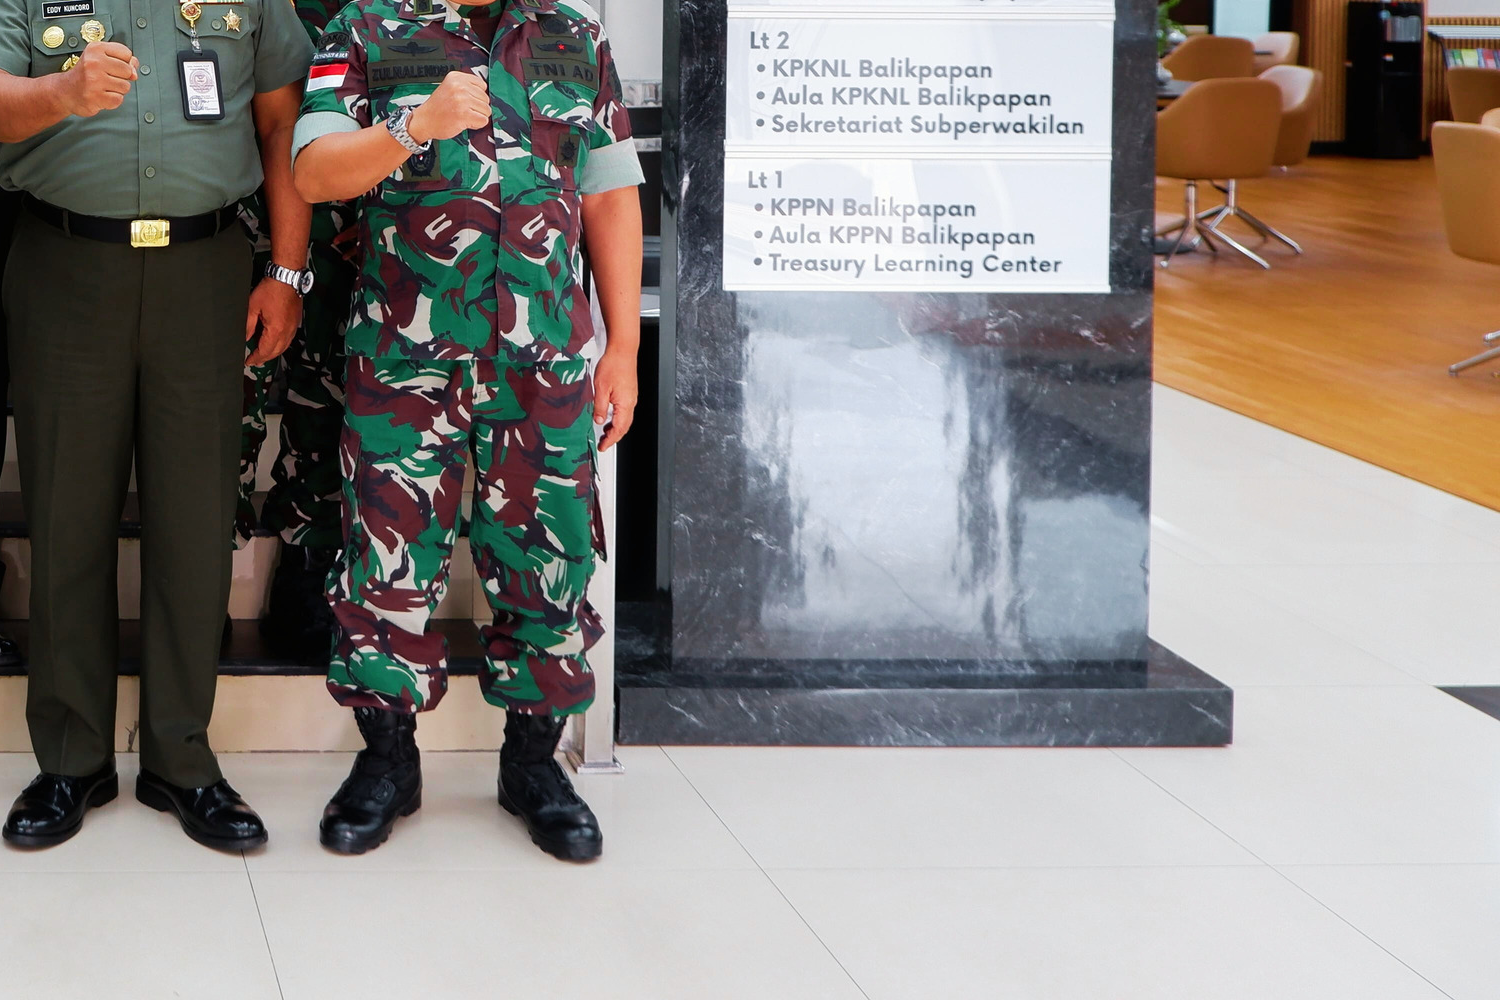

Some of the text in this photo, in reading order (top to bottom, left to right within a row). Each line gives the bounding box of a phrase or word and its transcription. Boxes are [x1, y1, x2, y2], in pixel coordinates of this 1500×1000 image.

[46, 6, 62, 14] EDDY
[750, 31, 790, 50] Lt 2
[529, 62, 594, 82] TNI AD
[772, 58, 993, 84] KPKNL Balikpapan
[771, 85, 1051, 112] Aula KPKNL Balikpapan
[771, 113, 1084, 140] Sekretariat Subperwakilan
[748, 170, 784, 189] Lt 1
[770, 197, 976, 223] KPPN Balikpapan
[769, 224, 1035, 251] Aula KPPN Balikpapan
[769, 253, 1062, 278] Treasury Learning Center
